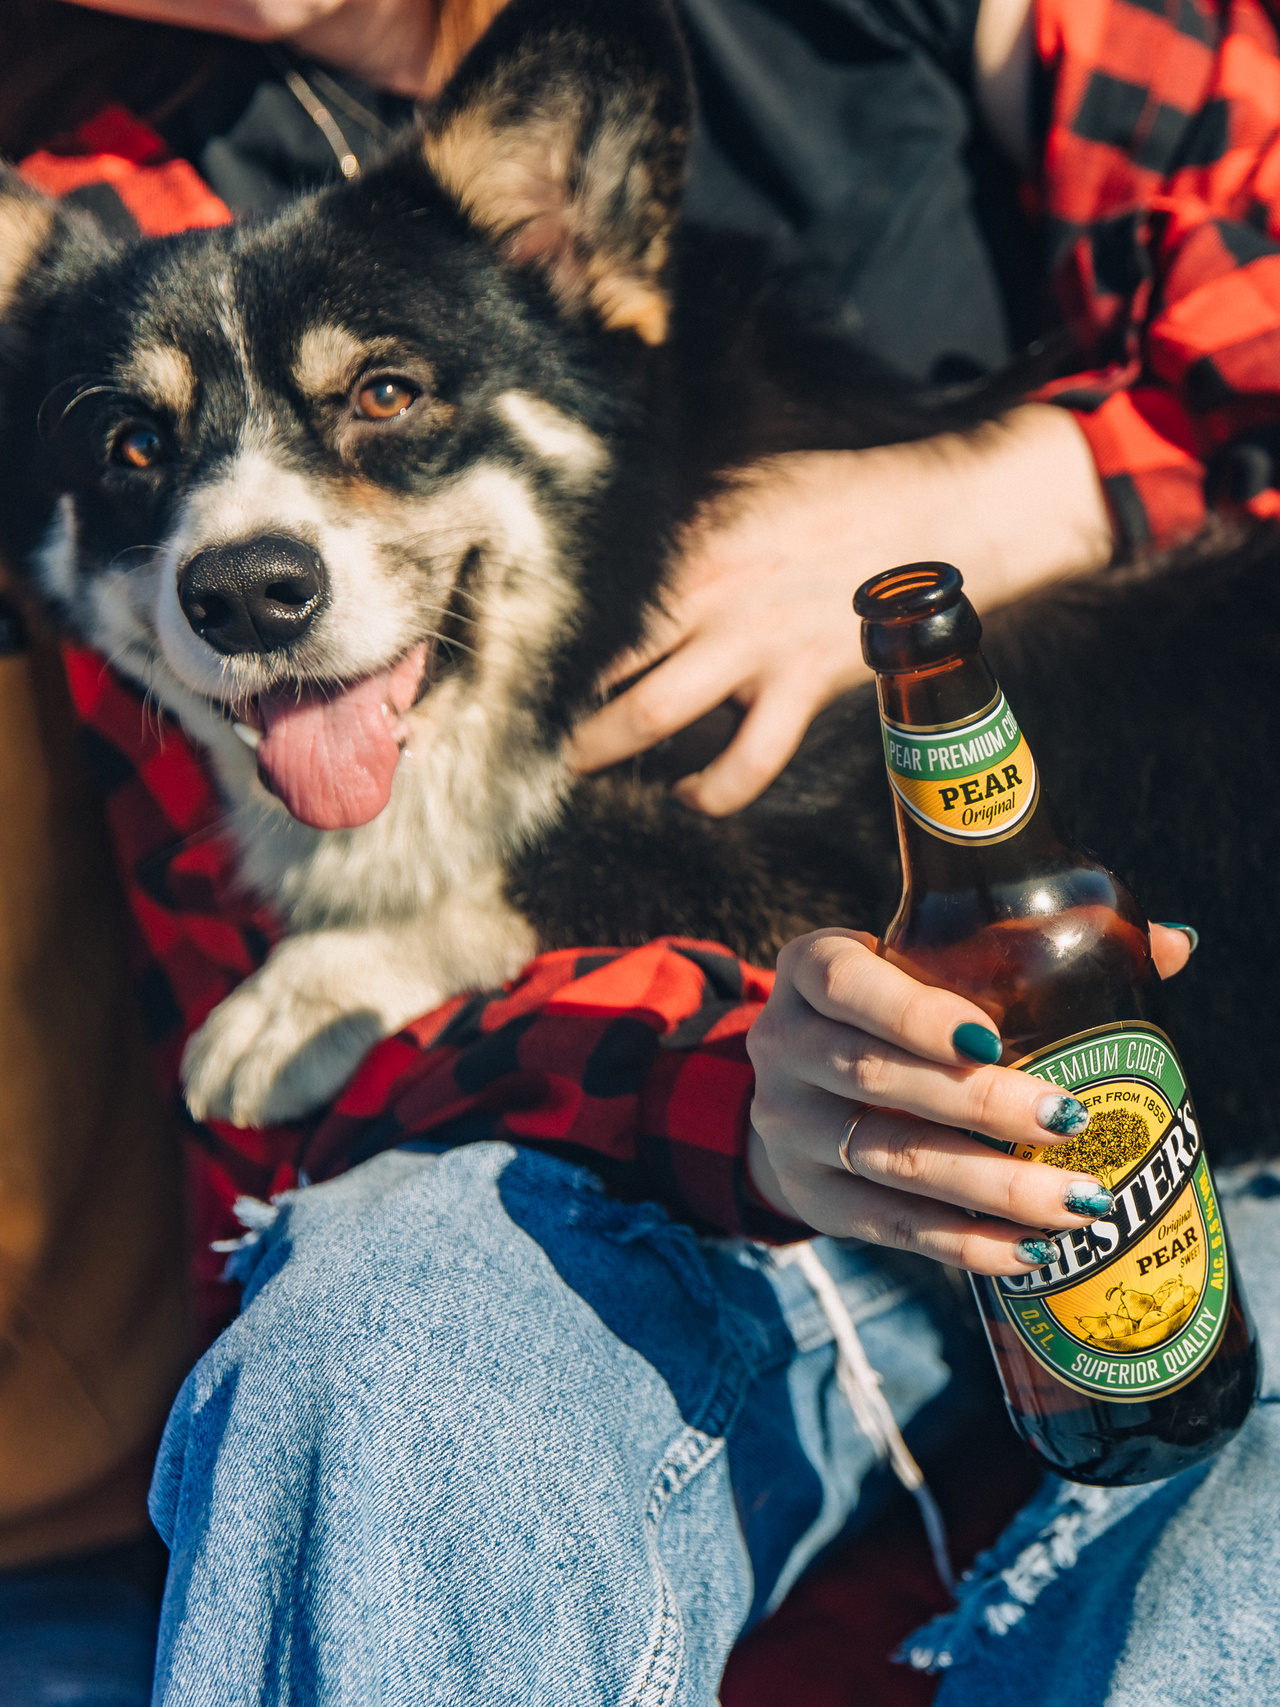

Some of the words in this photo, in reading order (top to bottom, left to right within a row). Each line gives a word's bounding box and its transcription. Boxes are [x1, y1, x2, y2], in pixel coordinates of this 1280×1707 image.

[890, 740, 922, 771] PEAR
[928, 726, 1006, 771] PREMIUM
[938, 764, 1023, 811] PEAR
[962, 791, 1015, 826] Original
[1033, 1042, 1119, 1088] EMIUM
[1126, 1041, 1166, 1080] CIDER
[1105, 1091, 1141, 1104] FROM
[1142, 1096, 1166, 1124] 1855
[1158, 1203, 1192, 1240] Original
[1136, 1226, 1198, 1276] PEAR
[1180, 1244, 1200, 1268] SWEET
[1210, 1251, 1224, 1290] ALC.
[1071, 1353, 1161, 1385] SUPERIOR
[1163, 1307, 1217, 1374] QUALITY
